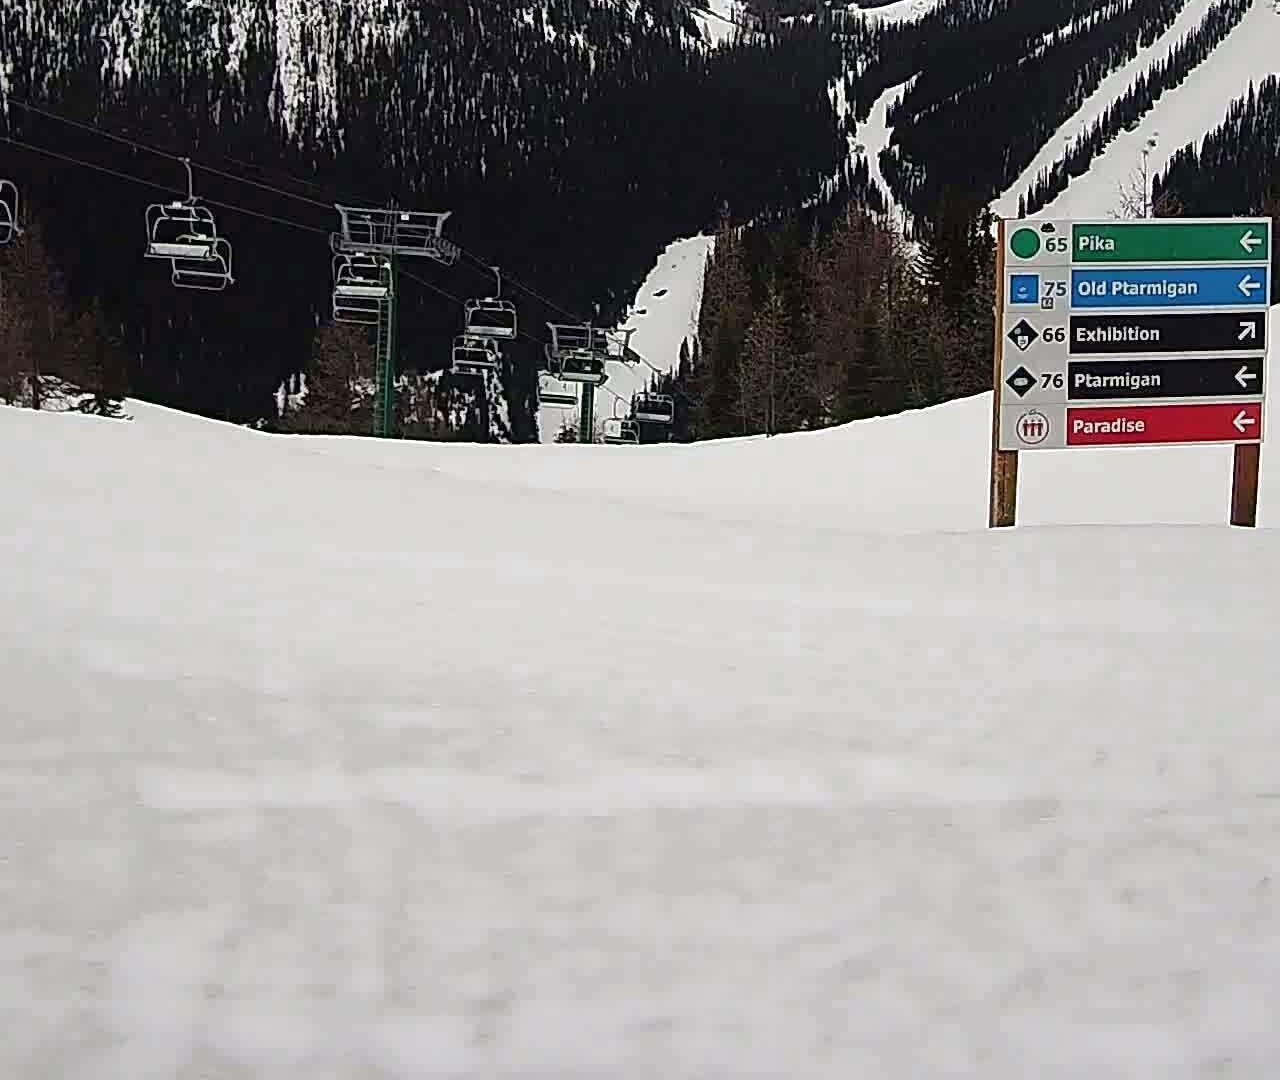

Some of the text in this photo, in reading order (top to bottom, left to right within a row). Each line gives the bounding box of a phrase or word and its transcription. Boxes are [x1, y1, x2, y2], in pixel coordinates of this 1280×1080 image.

[1044, 235, 1115, 253] 65 Pika
[1043, 281, 1198, 297] 75 Old Ptarmigan
[1042, 327, 1160, 343] 66 Exhibition
[1040, 373, 1161, 391] 76 Ptarmigan
[1072, 419, 1145, 434] Paradise
